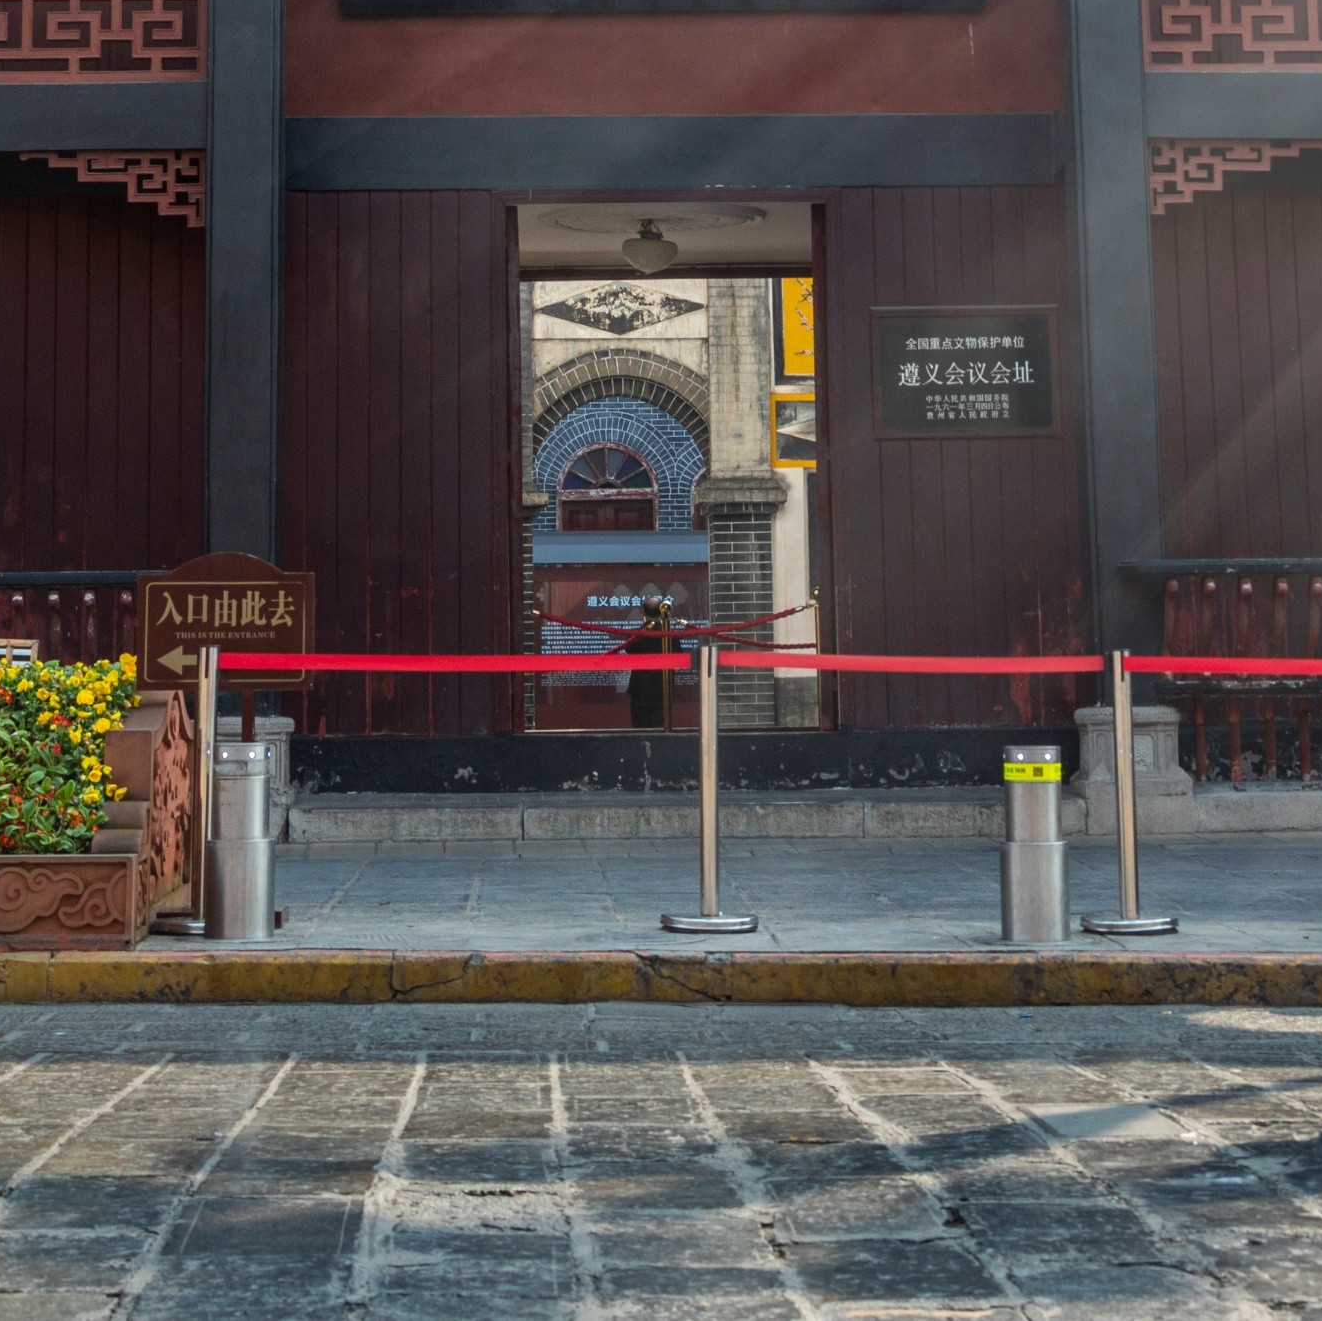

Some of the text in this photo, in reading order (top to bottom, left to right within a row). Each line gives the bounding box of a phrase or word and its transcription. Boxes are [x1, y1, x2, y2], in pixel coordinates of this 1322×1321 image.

[905, 336, 1025, 350] 全国重点文物保护单位
[898, 361, 1035, 386] 遵义会议会址
[925, 394, 1009, 403] 中华人民共和国国务院
[926, 402, 1010, 411] 一九六一年三月四日公布
[926, 410, 1010, 420] 贵州省人民政府立
[156, 590, 295, 627] 入口由此去
[175, 631, 276, 639] THIS IS THE ENTRANCE
